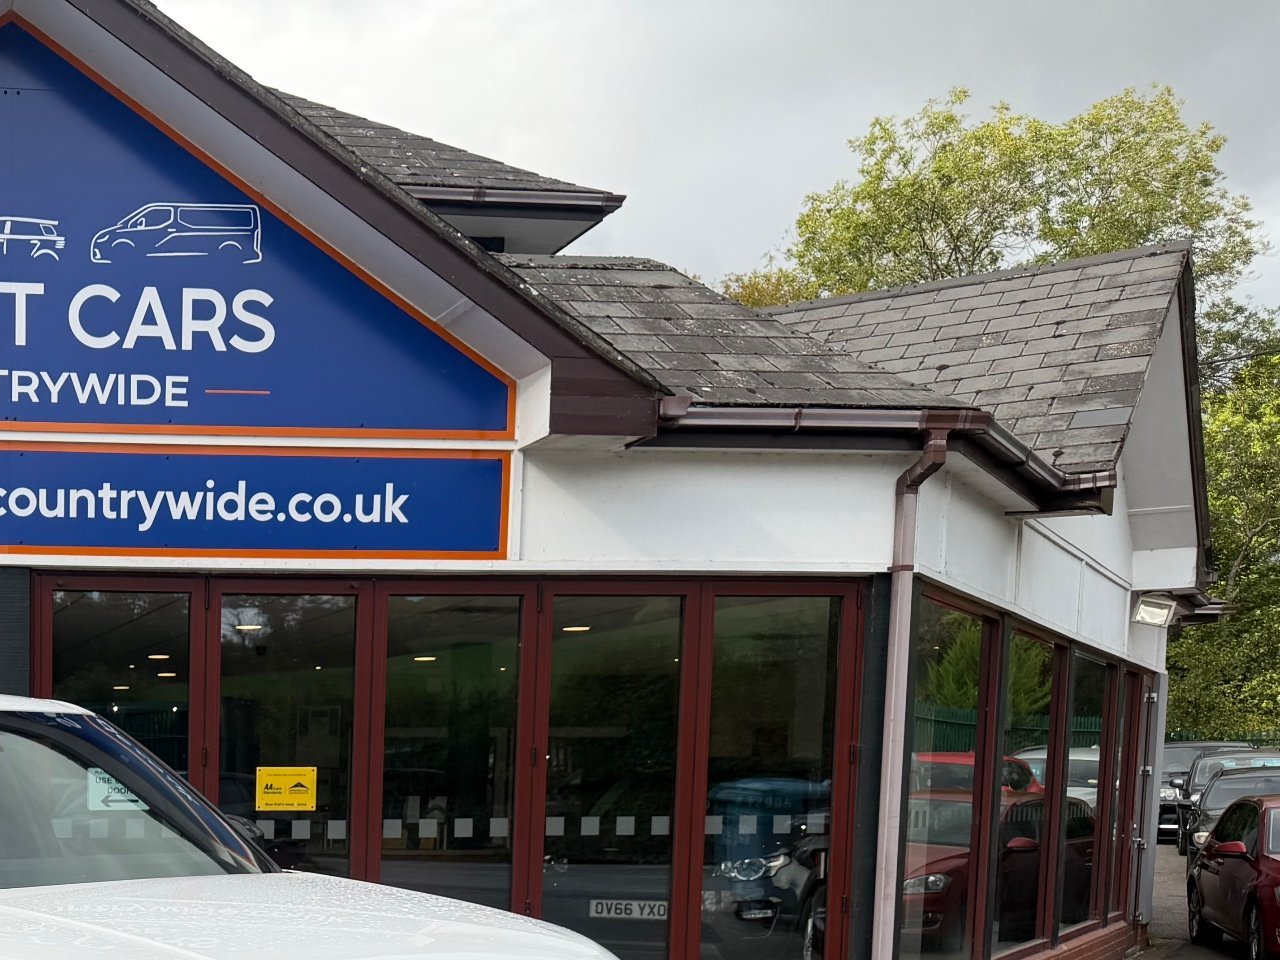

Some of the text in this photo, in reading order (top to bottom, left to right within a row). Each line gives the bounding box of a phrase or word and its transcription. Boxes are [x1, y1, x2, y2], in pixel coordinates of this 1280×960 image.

[68, 284, 276, 353] CARS
[95, 776, 113, 785] USE
[595, 902, 666, 917] OV66 YXO
